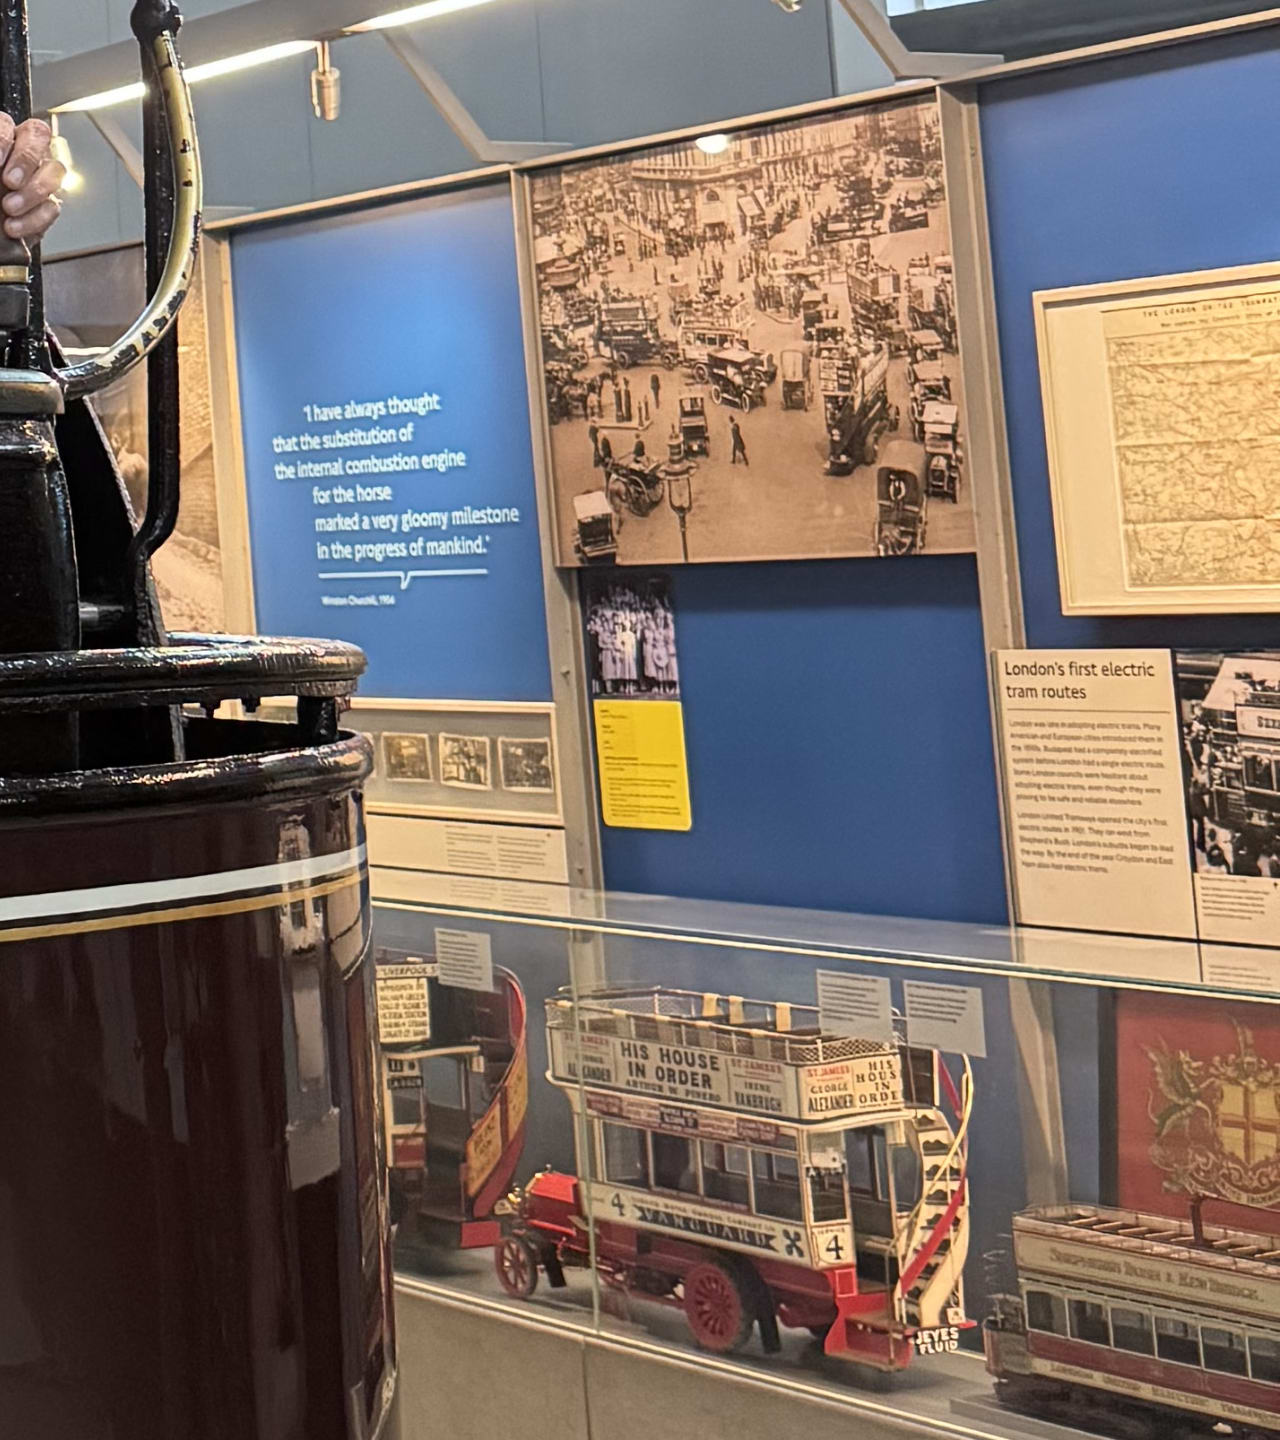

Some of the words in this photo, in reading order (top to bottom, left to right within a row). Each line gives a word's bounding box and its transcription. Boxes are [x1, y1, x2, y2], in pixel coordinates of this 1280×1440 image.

[313, 403, 343, 422] have
[344, 400, 386, 420] always
[387, 392, 442, 416] thought
[272, 435, 299, 453] that
[300, 433, 321, 450] the
[322, 426, 397, 449] substitution
[398, 422, 414, 442] of
[274, 461, 296, 479] the
[297, 457, 344, 477] internal
[345, 451, 419, 474] combustion
[421, 448, 466, 472] engine
[312, 486, 330, 504] for
[332, 485, 355, 503] the
[356, 484, 393, 502] horse
[315, 512, 359, 531] marked
[361, 515, 370, 530] a
[371, 514, 398, 533] very
[401, 509, 448, 533] gloomy
[451, 506, 519, 525] milestone
[317, 541, 329, 559] in
[330, 541, 352, 559] the
[354, 542, 407, 562] progress
[409, 537, 424, 557] of
[1004, 661, 1065, 677] London's
[1068, 661, 1097, 677] first
[1101, 662, 1155, 678] electric
[1006, 685, 1038, 699] tram
[1041, 685, 1087, 700] routes
[621, 1041, 649, 1060] HIS
[659, 1047, 720, 1072] HOUSE
[868, 1060, 893, 1071] HIS
[628, 1061, 646, 1079] IN
[655, 1065, 712, 1090] ORDER
[855, 1070, 897, 1084] HOUS
[810, 1083, 849, 1095] GEORGE
[858, 1090, 899, 1105] ORDE
[875, 1081, 891, 1093] IN
[808, 1093, 855, 1114] ALEXANDER
[611, 1192, 626, 1217] 4
[641, 1209, 768, 1248] VANGUARD
[825, 1234, 845, 1260] 4
[915, 1327, 959, 1345] JEYES
[920, 1340, 958, 1355] FLUID
